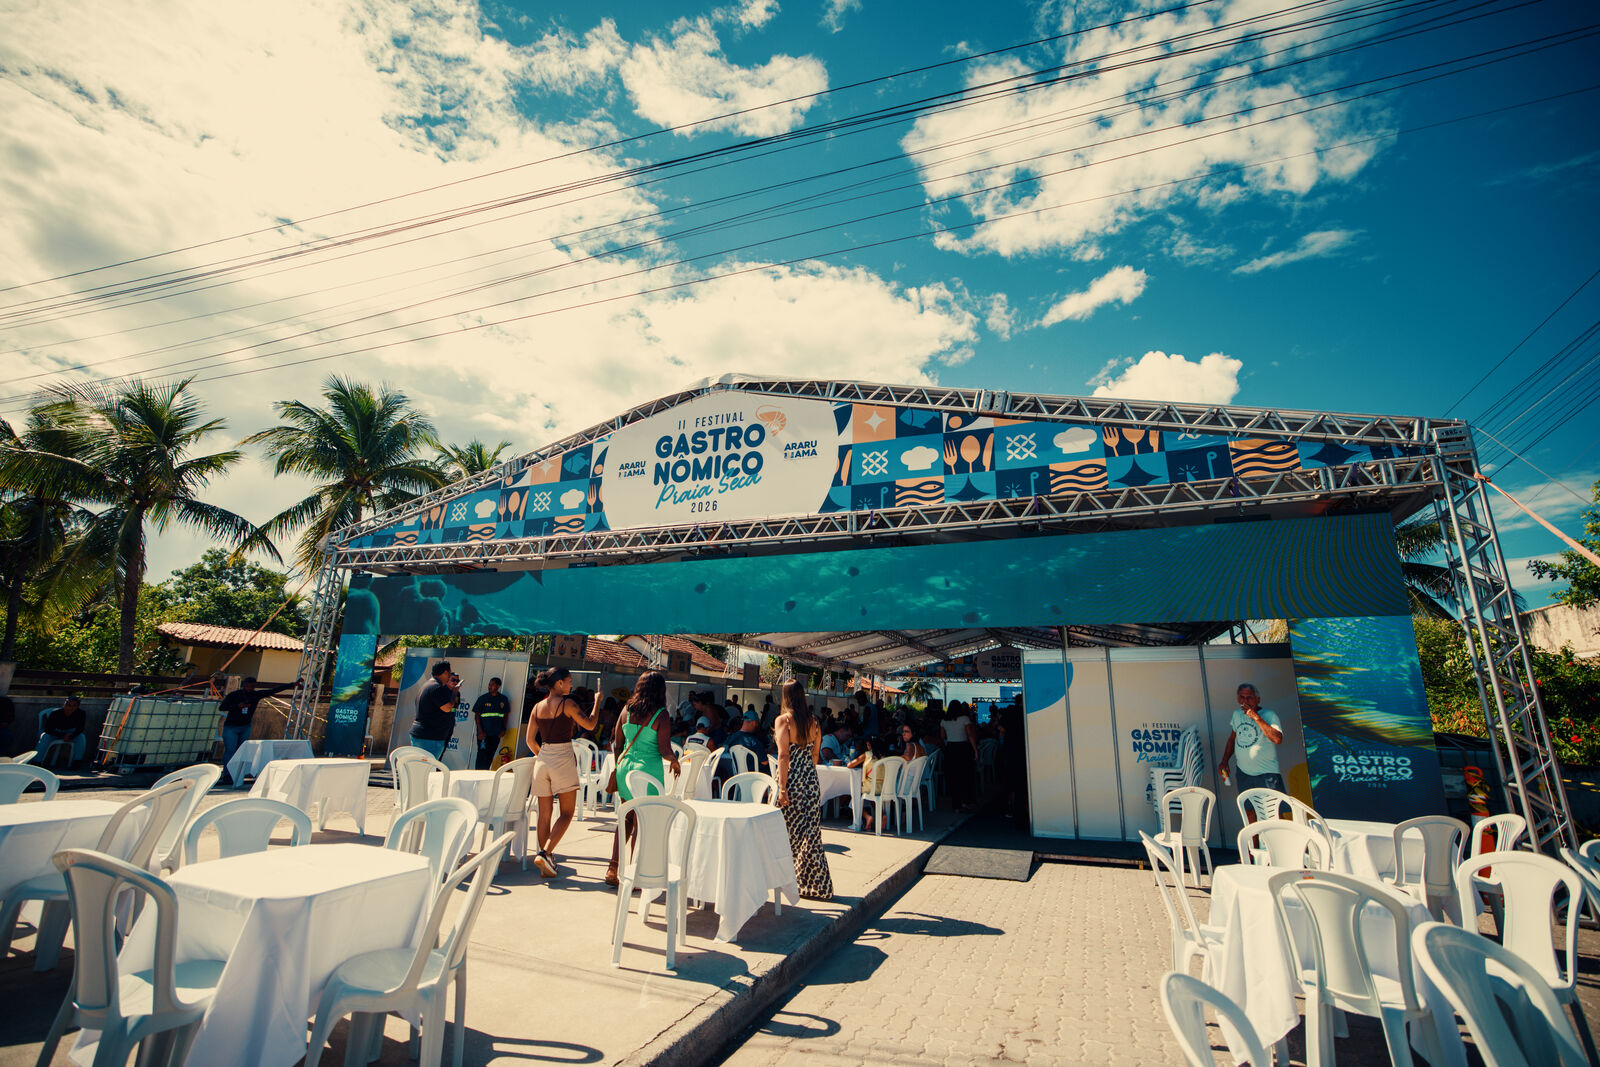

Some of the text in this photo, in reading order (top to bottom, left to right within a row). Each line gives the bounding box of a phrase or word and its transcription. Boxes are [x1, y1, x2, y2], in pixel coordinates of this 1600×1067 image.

[678, 411, 745, 430] II FESTIVAL
[655, 423, 766, 458] GASTRO
[784, 440, 818, 451] ARARU
[618, 460, 646, 470] ARARU
[653, 452, 764, 486] NÔMICO
[655, 468, 762, 509] Praia Seca
[690, 500, 718, 513] 2026
[1131, 729, 1181, 741] GASTR
[1132, 739, 1180, 753] NÔMIC
[1332, 755, 1412, 766] GASTRO
